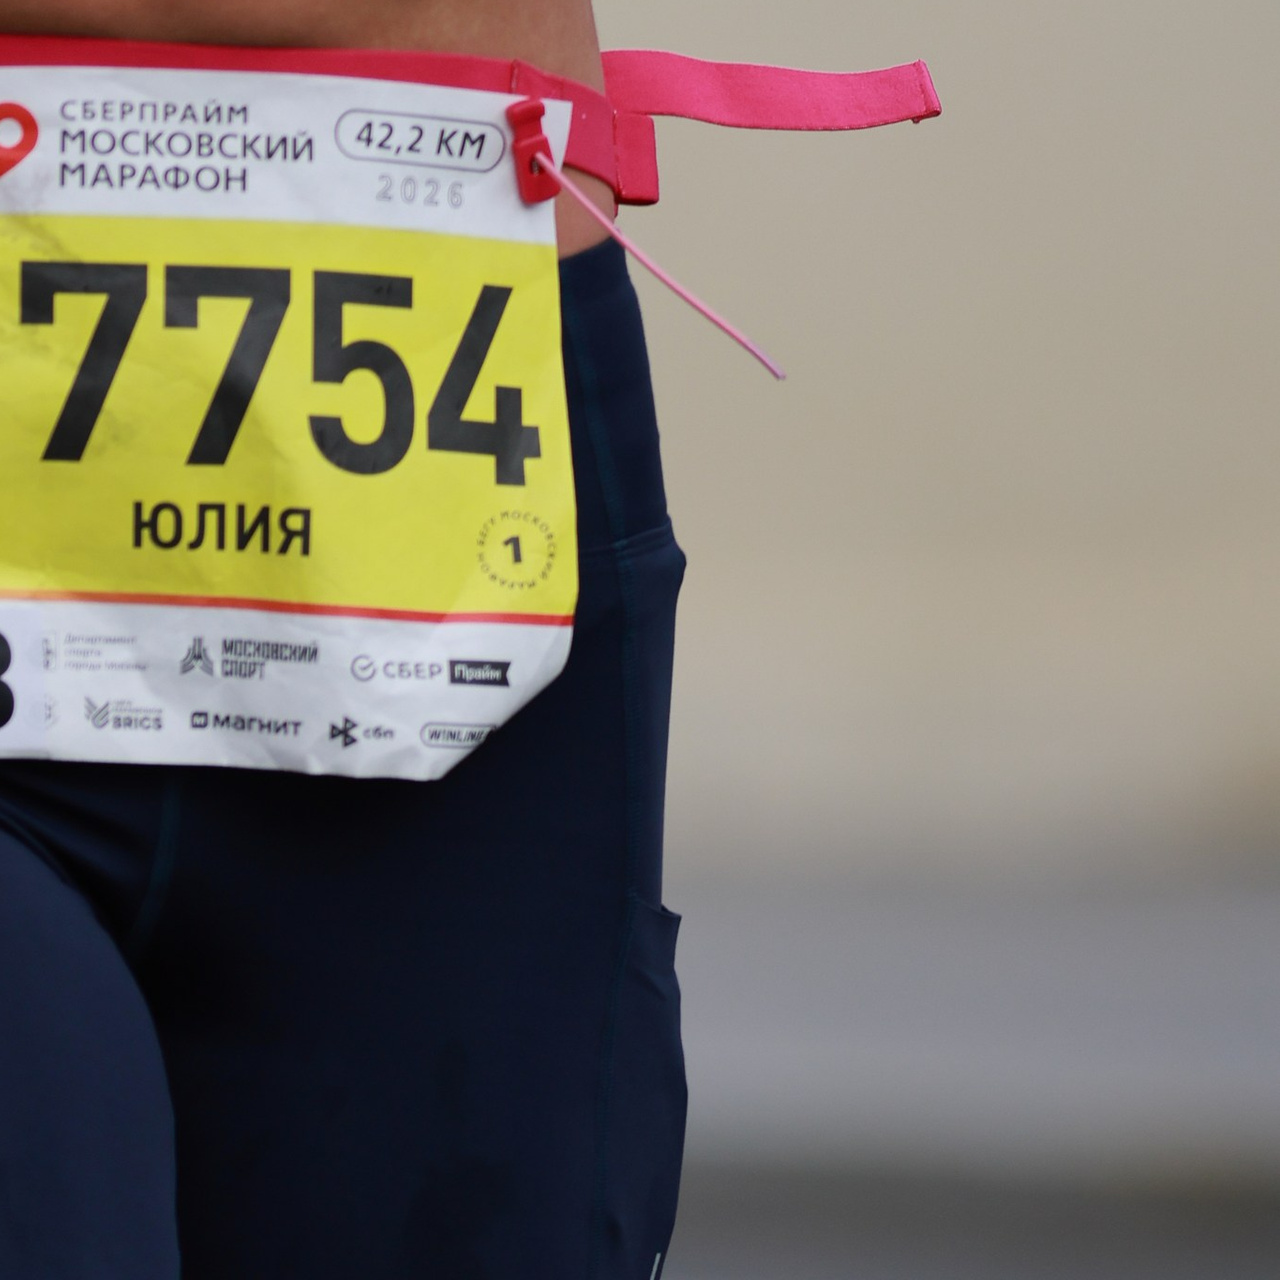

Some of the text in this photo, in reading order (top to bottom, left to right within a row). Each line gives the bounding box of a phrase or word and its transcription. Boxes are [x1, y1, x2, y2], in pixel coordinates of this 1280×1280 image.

[60, 99, 250, 126] СБЕРПРАЙМ
[59, 128, 315, 162] МОСКОВСКИЙ
[355, 123, 427, 158] 42,2
[59, 163, 249, 193] МАРАФОН
[375, 174, 466, 209] 2026
[132, 501, 312, 557] ЮЛИЯ
[502, 535, 523, 564] 1
[221, 638, 320, 663] МОСКОВСКИЙ
[221, 659, 265, 679] СПОРТ
[383, 660, 502, 682] СБЕР Прайм
[213, 713, 304, 736] магнит
